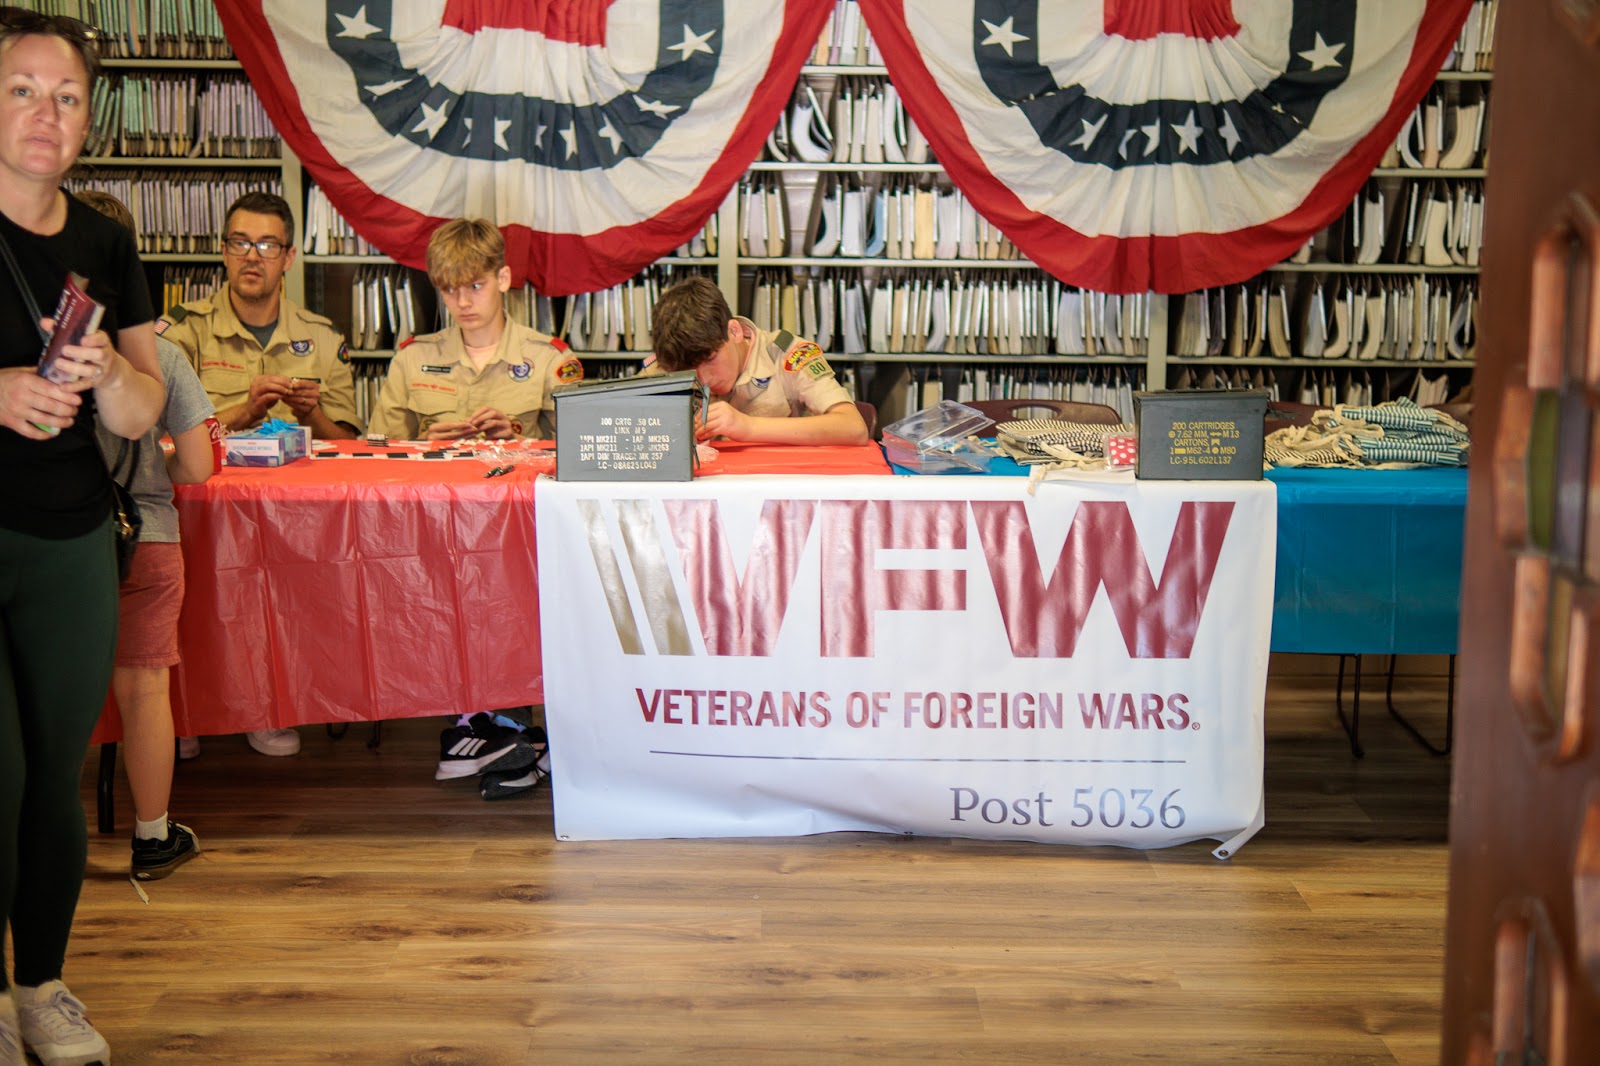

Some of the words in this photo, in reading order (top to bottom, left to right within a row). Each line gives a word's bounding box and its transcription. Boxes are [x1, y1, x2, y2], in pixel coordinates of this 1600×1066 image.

[809, 361, 826, 375] 80
[601, 417, 612, 426] 100
[615, 417, 632, 426] CRTG
[648, 417, 661, 426] CAL
[1172, 422, 1187, 430] 200
[1188, 422, 1235, 430] CARTRIDGES
[1177, 430, 1193, 438] 7.62
[596, 435, 617, 443] MK211
[1220, 447, 1237, 455] M80
[664, 500, 1236, 659] VFW
[635, 688, 832, 728] VETERANS
[846, 691, 890, 728] OF
[903, 691, 1063, 729] FOREIGN
[950, 787, 1053, 827] Post
[1071, 785, 1186, 829] 5036
